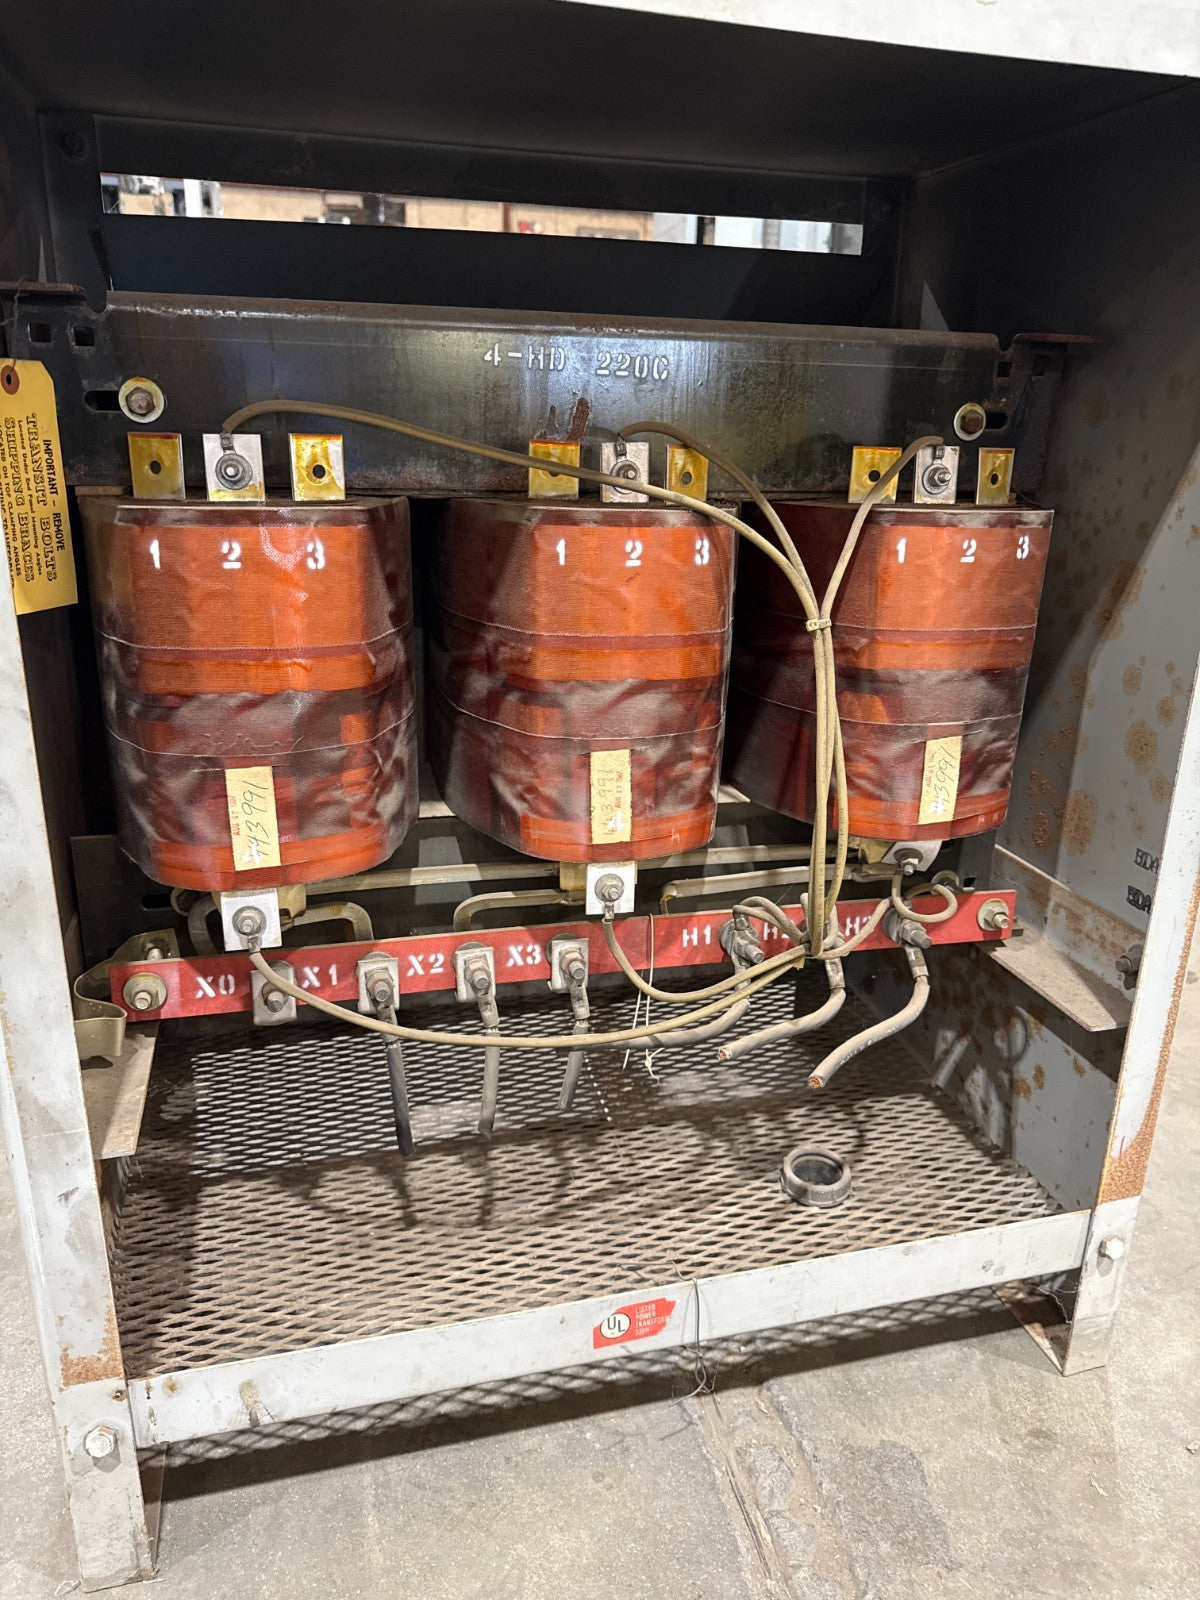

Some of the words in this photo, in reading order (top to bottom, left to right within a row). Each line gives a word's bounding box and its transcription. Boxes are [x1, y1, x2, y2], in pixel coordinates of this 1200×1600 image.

[596, 351, 669, 380] 220C
[4, 417, 25, 507] SHIPPING
[18, 511, 35, 582] BRACES
[18, 420, 26, 450] Located
[31, 516, 39, 549] Mounting
[26, 412, 47, 506] TRANSIT
[40, 516, 57, 582] BOLTS
[43, 439, 58, 496] IMPORTANT
[52, 512, 65, 551] REMOVE
[2, 465, 8, 479] ON
[7, 501, 17, 542] CLAMPING
[13, 546, 22, 577] ANGLES
[149, 539, 161, 570] 1
[220, 540, 242, 570] 2
[306, 537, 326, 570] 3
[555, 538, 566, 566] 1
[624, 540, 643, 567] 2
[694, 538, 710, 566] 3
[896, 537, 907, 564] 1
[960, 539, 977, 563] 2
[1016, 535, 1030, 560] 3
[194, 974, 235, 999] X0
[302, 963, 338, 988] X1
[406, 951, 445, 977] X2
[506, 941, 543, 968] X3
[682, 923, 712, 948] H1
[607, 1315, 626, 1333] UL
[635, 1303, 656, 1314] LISTED
[635, 1311, 657, 1321] POWER
